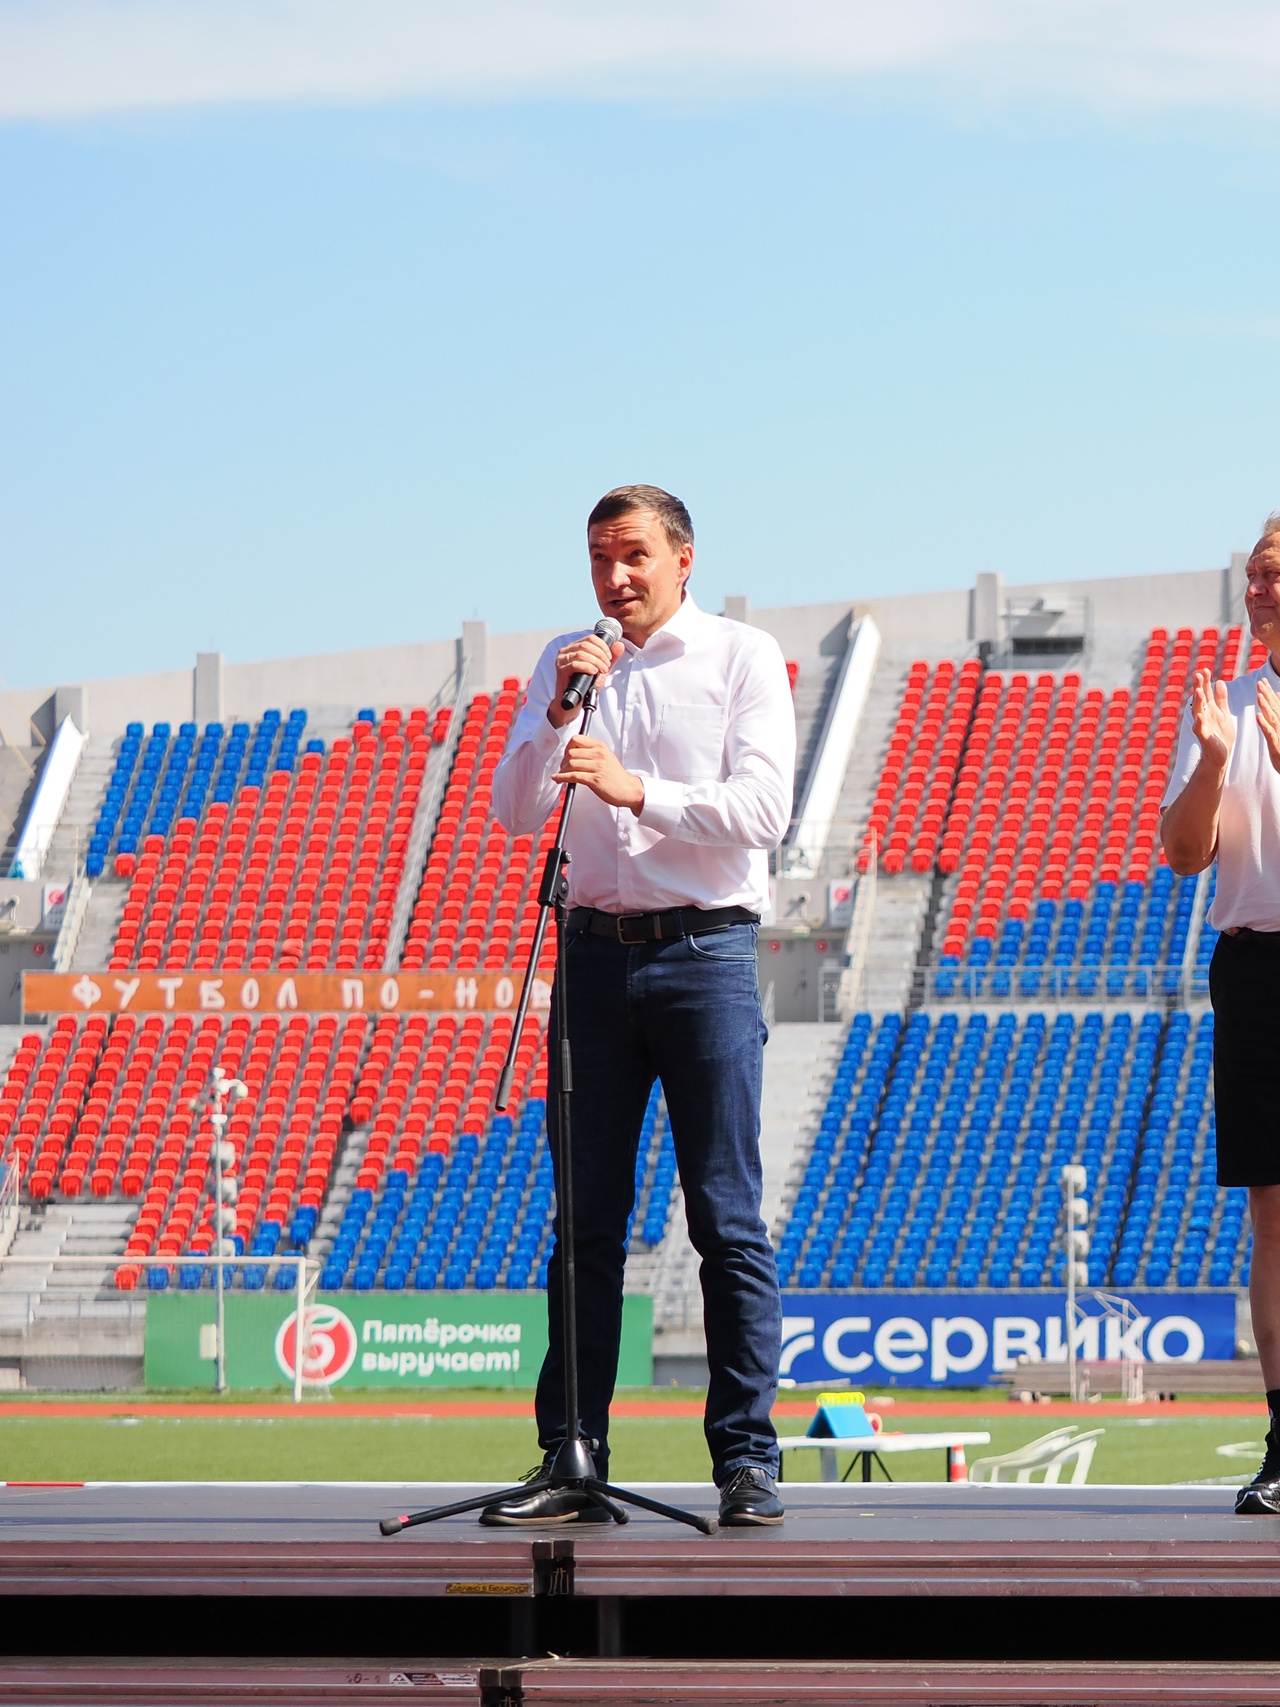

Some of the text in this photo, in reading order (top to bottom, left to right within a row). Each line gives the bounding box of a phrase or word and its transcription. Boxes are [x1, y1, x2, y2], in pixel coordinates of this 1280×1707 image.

[72, 975, 299, 1010] ФУТБОЛ
[363, 1318, 521, 1348] Пятёрочка
[822, 1315, 1205, 1382] сервико
[362, 1349, 520, 1377] выручает!
